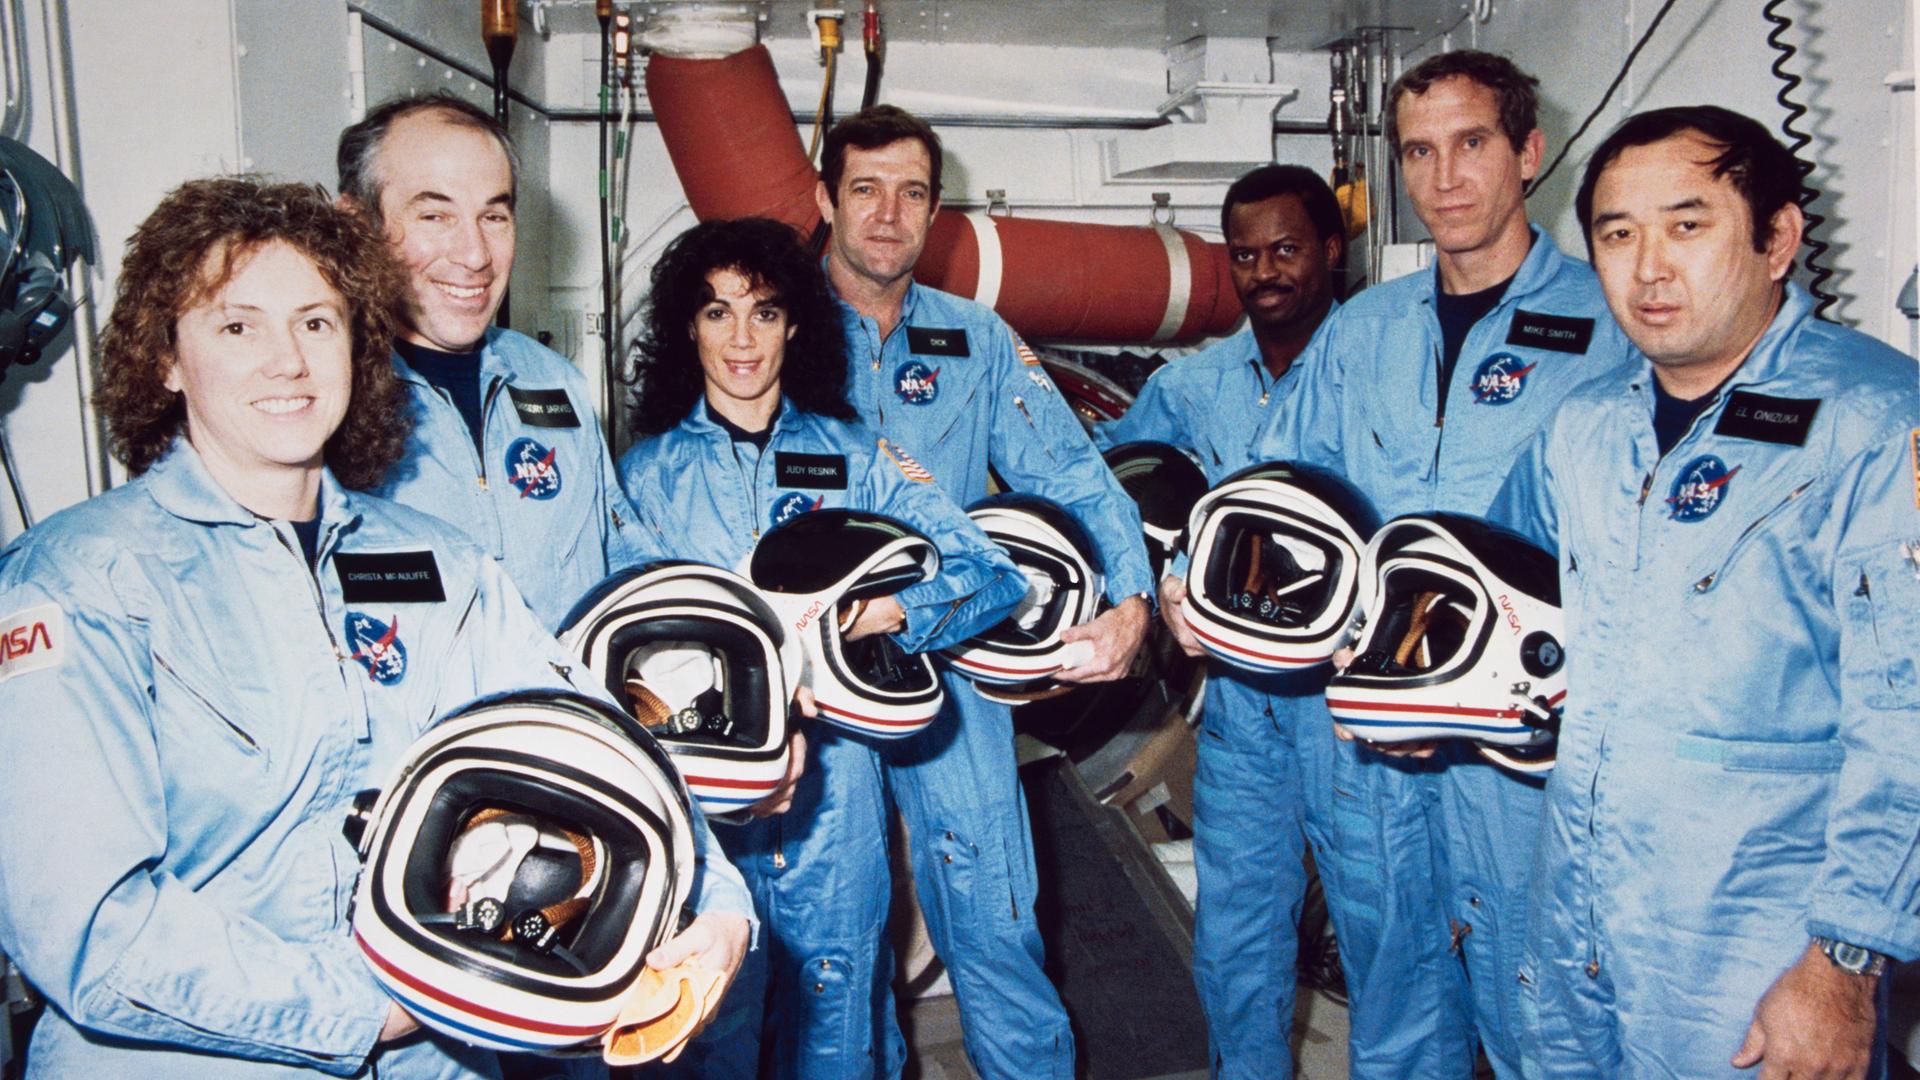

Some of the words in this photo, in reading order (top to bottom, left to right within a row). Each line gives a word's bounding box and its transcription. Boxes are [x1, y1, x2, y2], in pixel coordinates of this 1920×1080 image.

[1522, 325, 1546, 337] MIKE
[1547, 328, 1577, 340] SMITH
[901, 379, 935, 393] NASA
[1479, 374, 1521, 389] NASA
[1753, 409, 1799, 425] ONIZUKA
[513, 462, 558, 480] NASA
[785, 465, 806, 475] JUDY
[808, 466, 838, 476] RESNIK
[347, 572, 384, 581] CHRISTA
[795, 600, 824, 632] NASA
[1498, 594, 1521, 636] NASA
[0, 622, 52, 666] ASA
